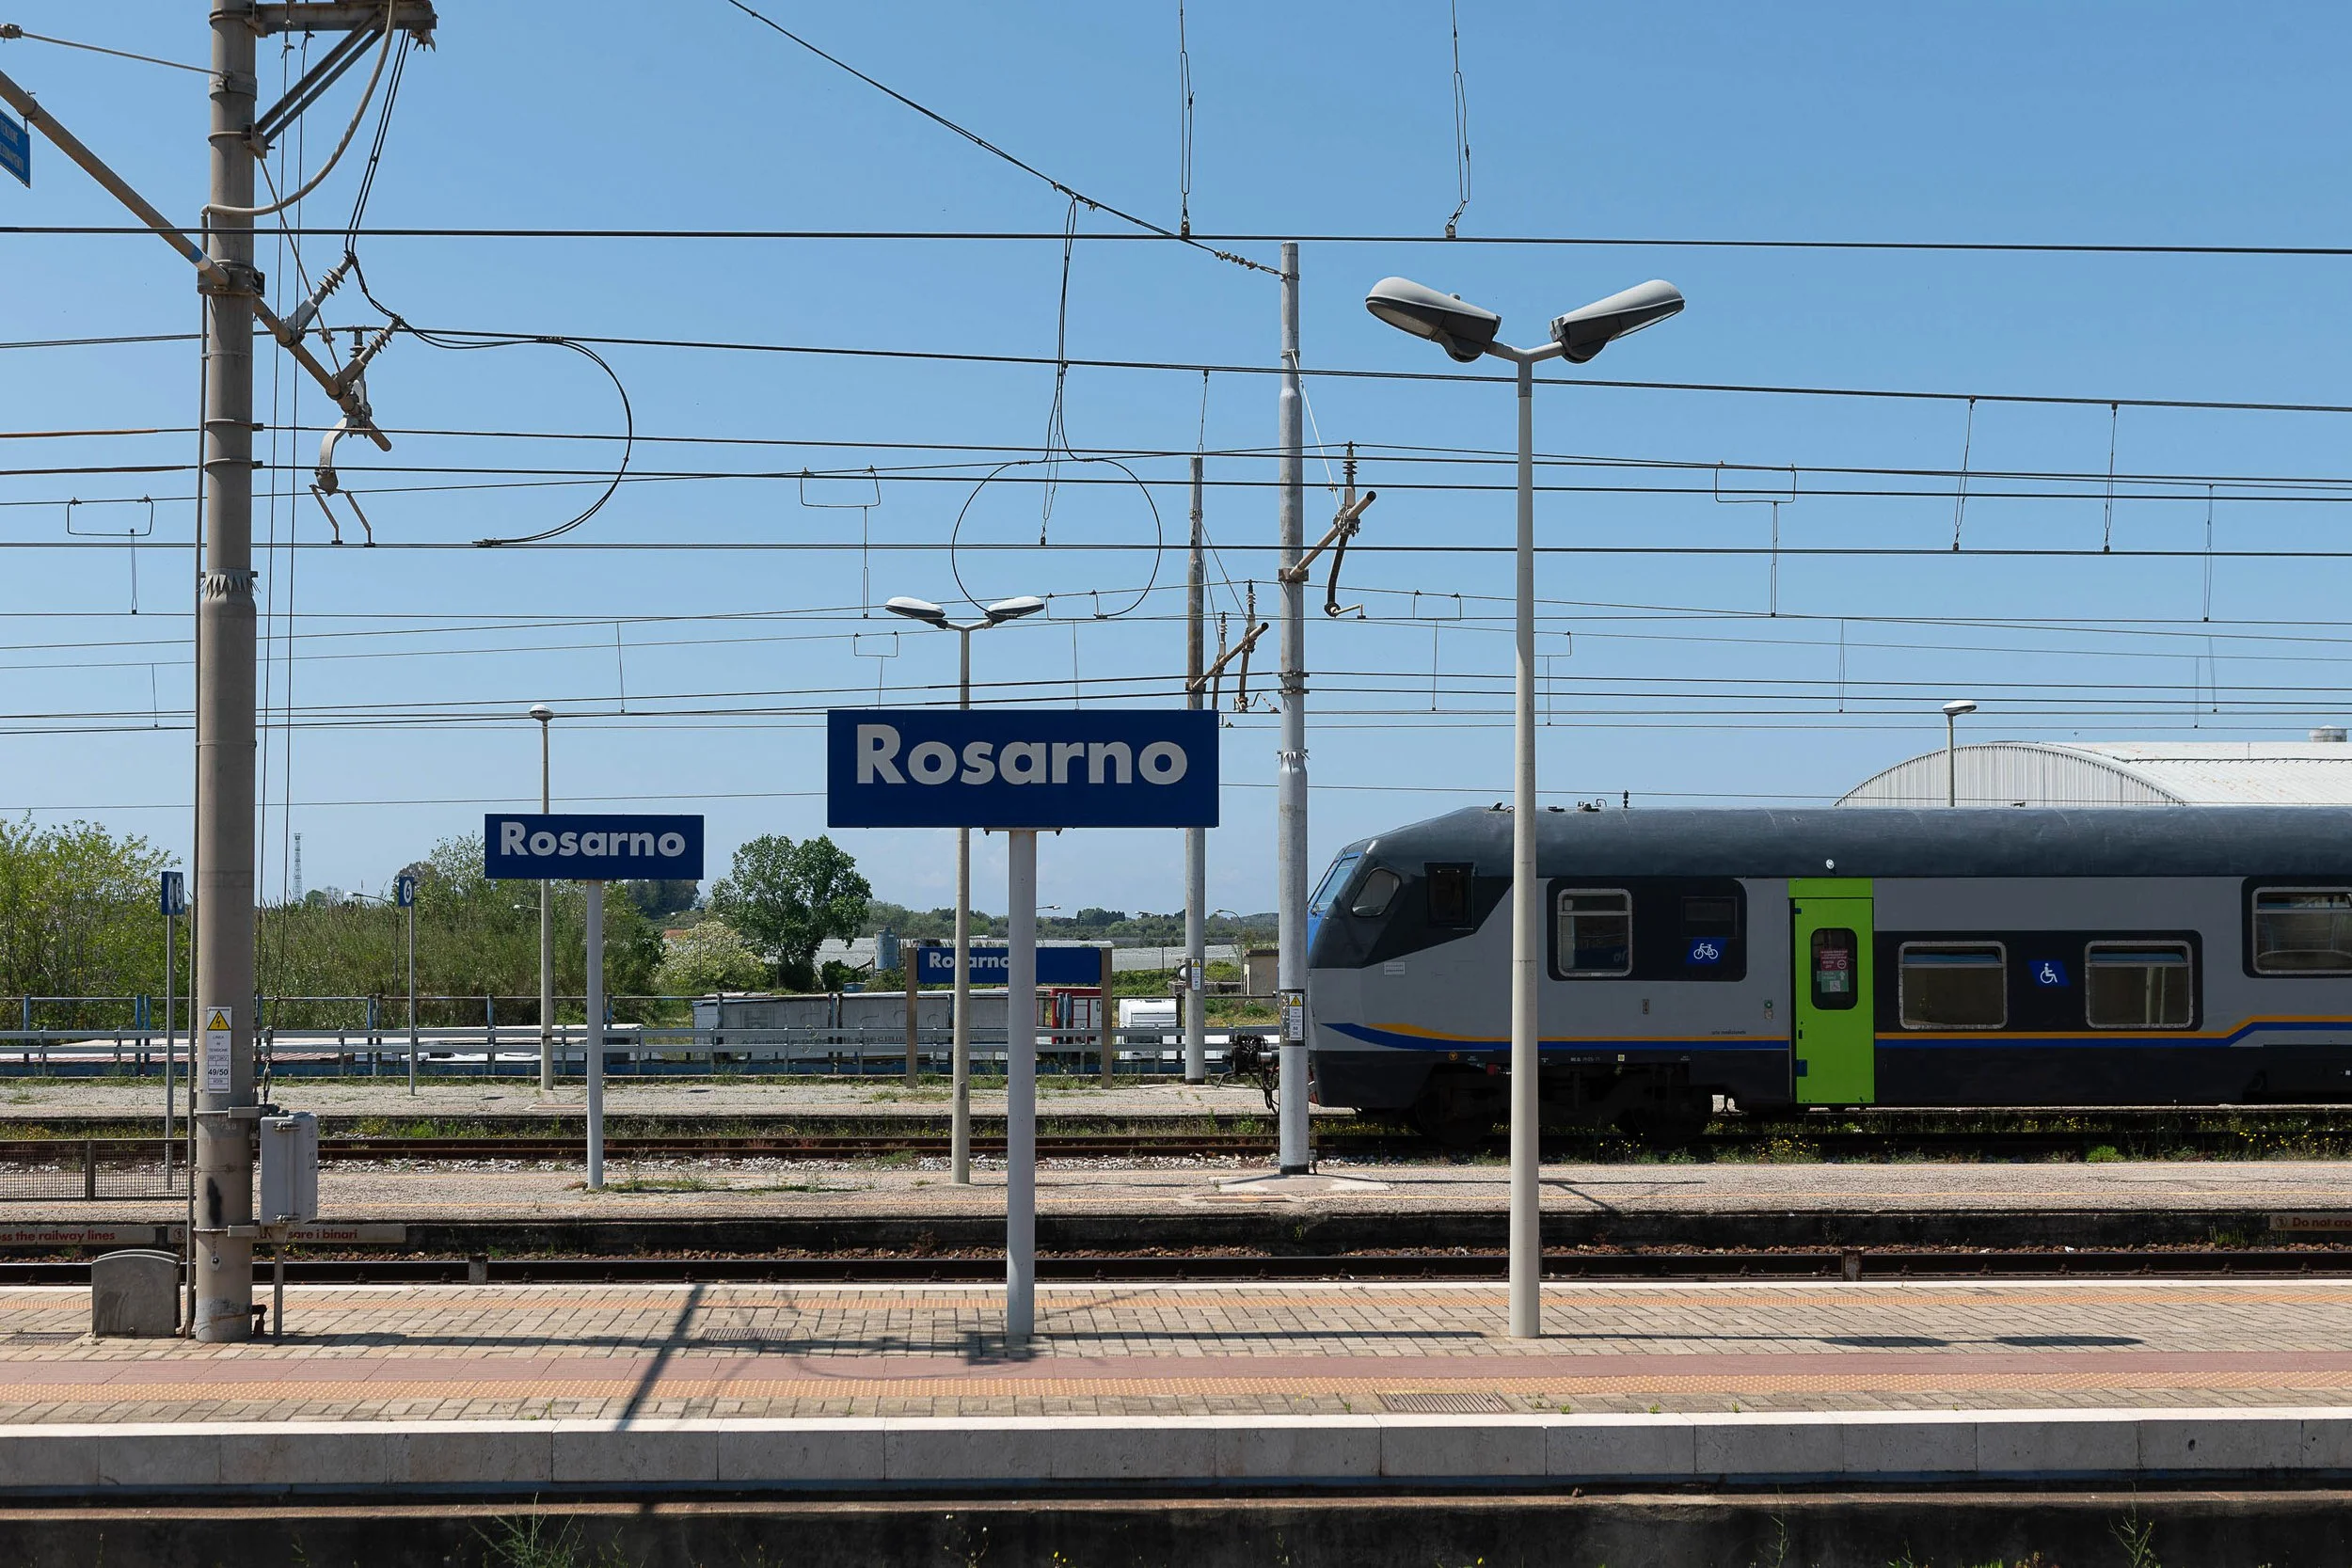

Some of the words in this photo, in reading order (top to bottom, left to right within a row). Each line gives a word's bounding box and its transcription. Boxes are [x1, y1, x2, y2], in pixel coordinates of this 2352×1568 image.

[856, 723, 1188, 785] Rosarno
[501, 821, 686, 857] Rosarno
[929, 952, 1009, 969] Roarno
[2293, 1217, 2309, 1227] Do
[2312, 1217, 2330, 1227] not
[15, 1230, 35, 1242] the
[39, 1229, 84, 1243] railway
[87, 1229, 115, 1241] lines
[316, 1228, 319, 1239] i
[323, 1228, 358, 1240] binari
